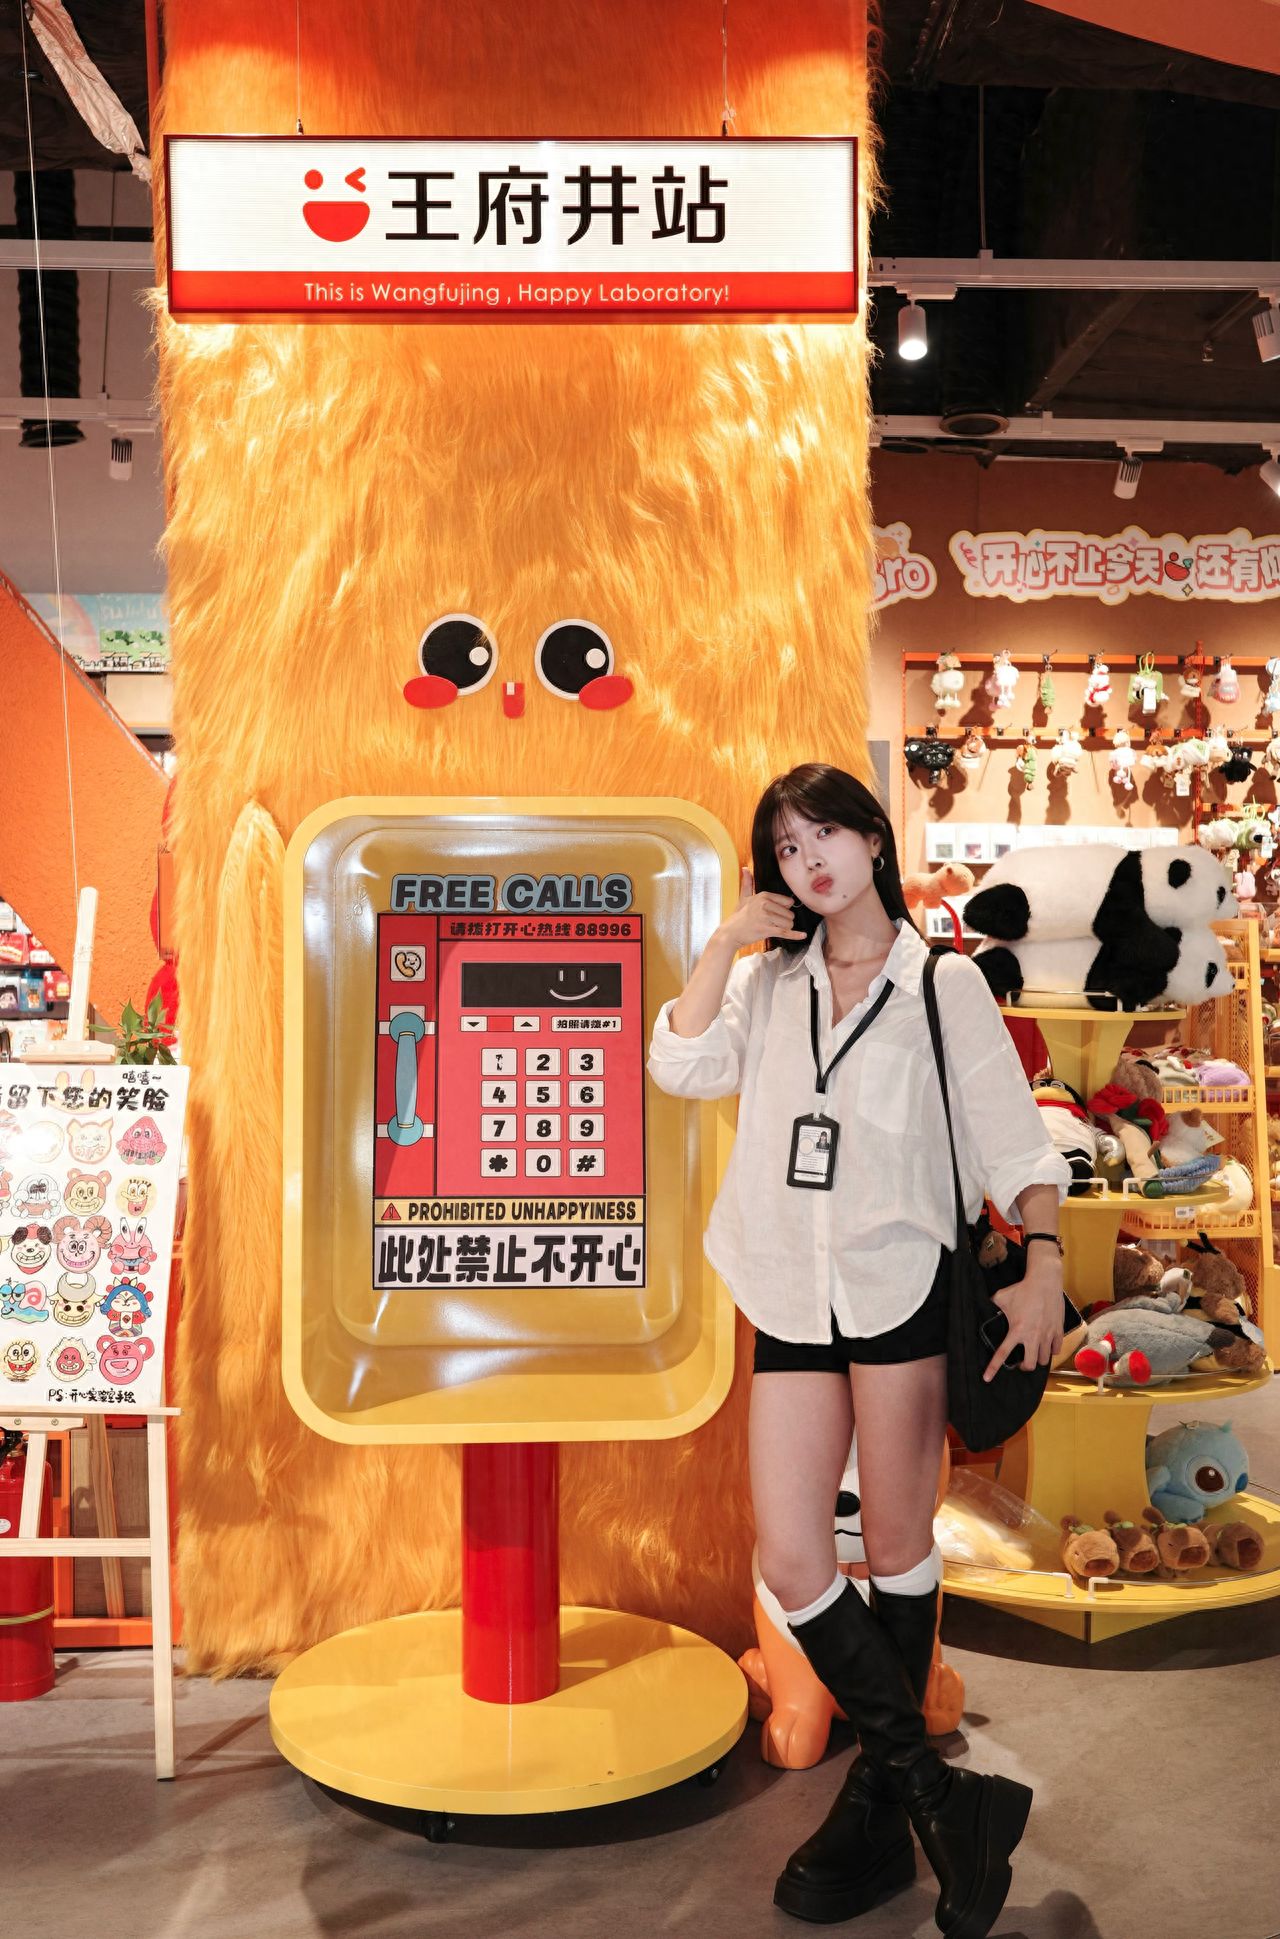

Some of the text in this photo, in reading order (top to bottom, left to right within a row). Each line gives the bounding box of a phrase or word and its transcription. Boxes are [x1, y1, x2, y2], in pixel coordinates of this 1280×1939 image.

[386, 165, 728, 246] 王府井站
[304, 282, 344, 302] This
[350, 282, 364, 302] is
[371, 282, 500, 306] Wangfujing
[518, 283, 593, 305] Happy
[599, 283, 729, 306] Laboratory!
[394, 877, 631, 910] FREE CALLS
[450, 922, 632, 938] 请拨打开心热线 88996
[536, 1053, 551, 1071] 2
[579, 1053, 594, 1072] 3
[0, 1084, 169, 1112] 留下您的笑脸
[492, 1086, 595, 1104] 4 5 6
[493, 1119, 595, 1138] 7 8 9
[536, 1154, 552, 1173] 0
[576, 1154, 597, 1172] #
[408, 1201, 637, 1221] PROHIBITED UNHAPPYINESS
[378, 1234, 641, 1284] 此处禁止不开心
